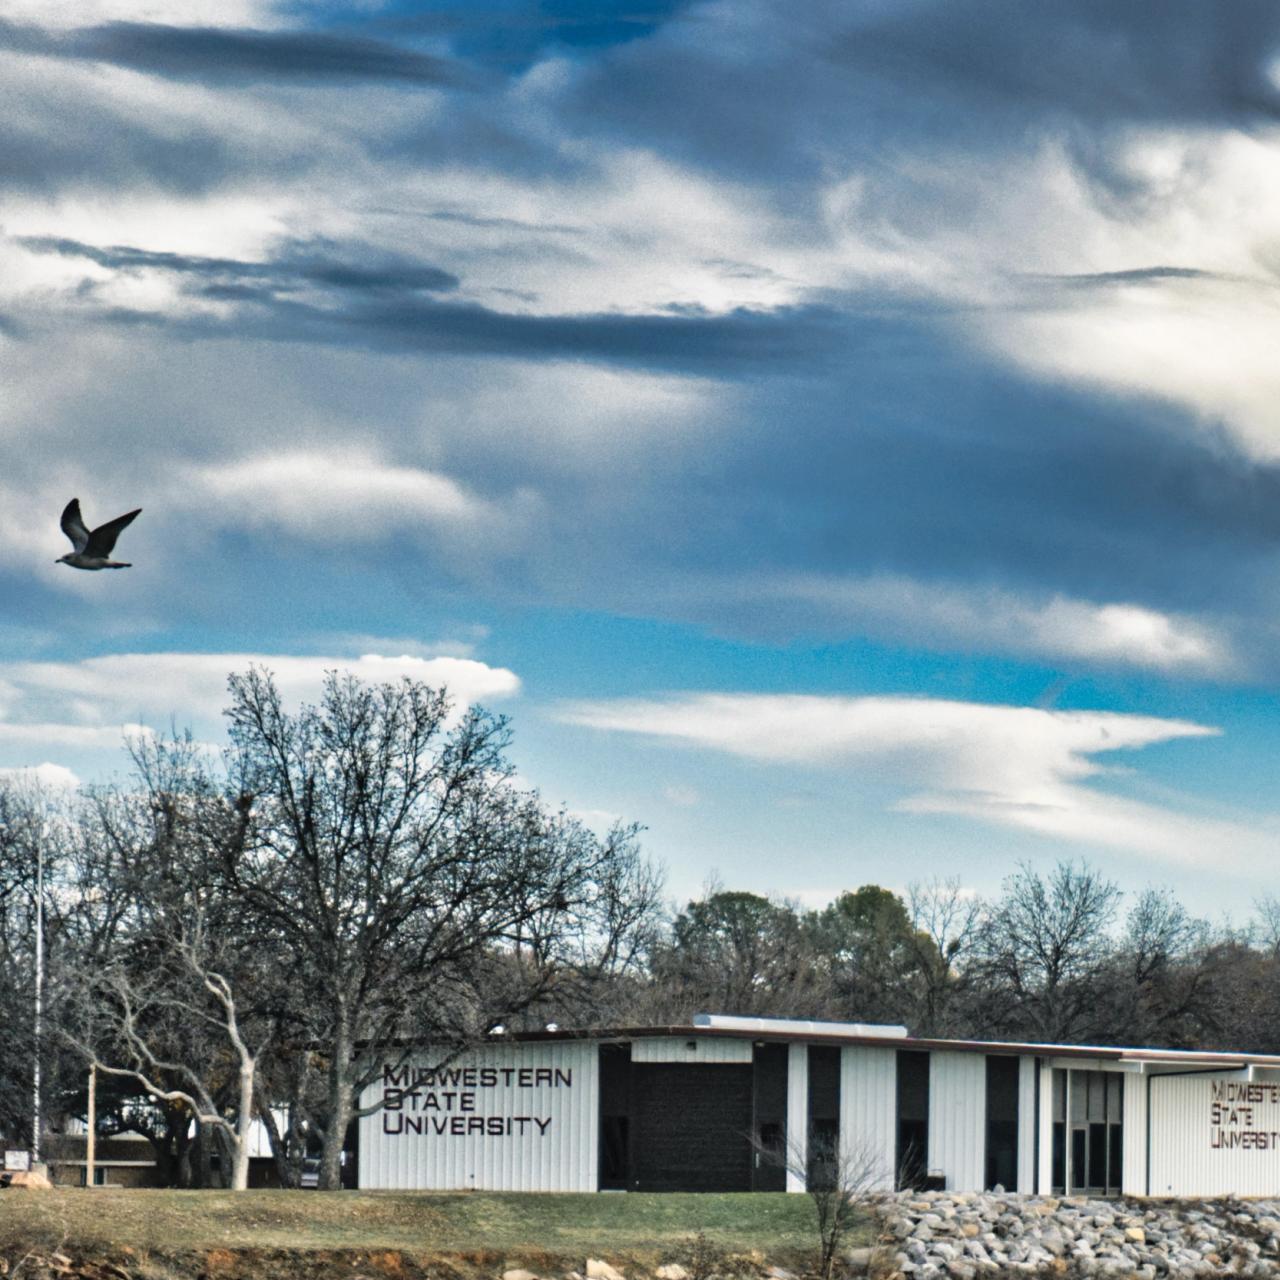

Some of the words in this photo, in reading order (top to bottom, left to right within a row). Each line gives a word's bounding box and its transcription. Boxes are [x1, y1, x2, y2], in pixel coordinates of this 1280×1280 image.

[383, 1064, 572, 1088] MIDWESTERN
[383, 1088, 475, 1111] STATE
[383, 1113, 552, 1135] UNIVERSITY
[1212, 1103, 1253, 1125] STATE
